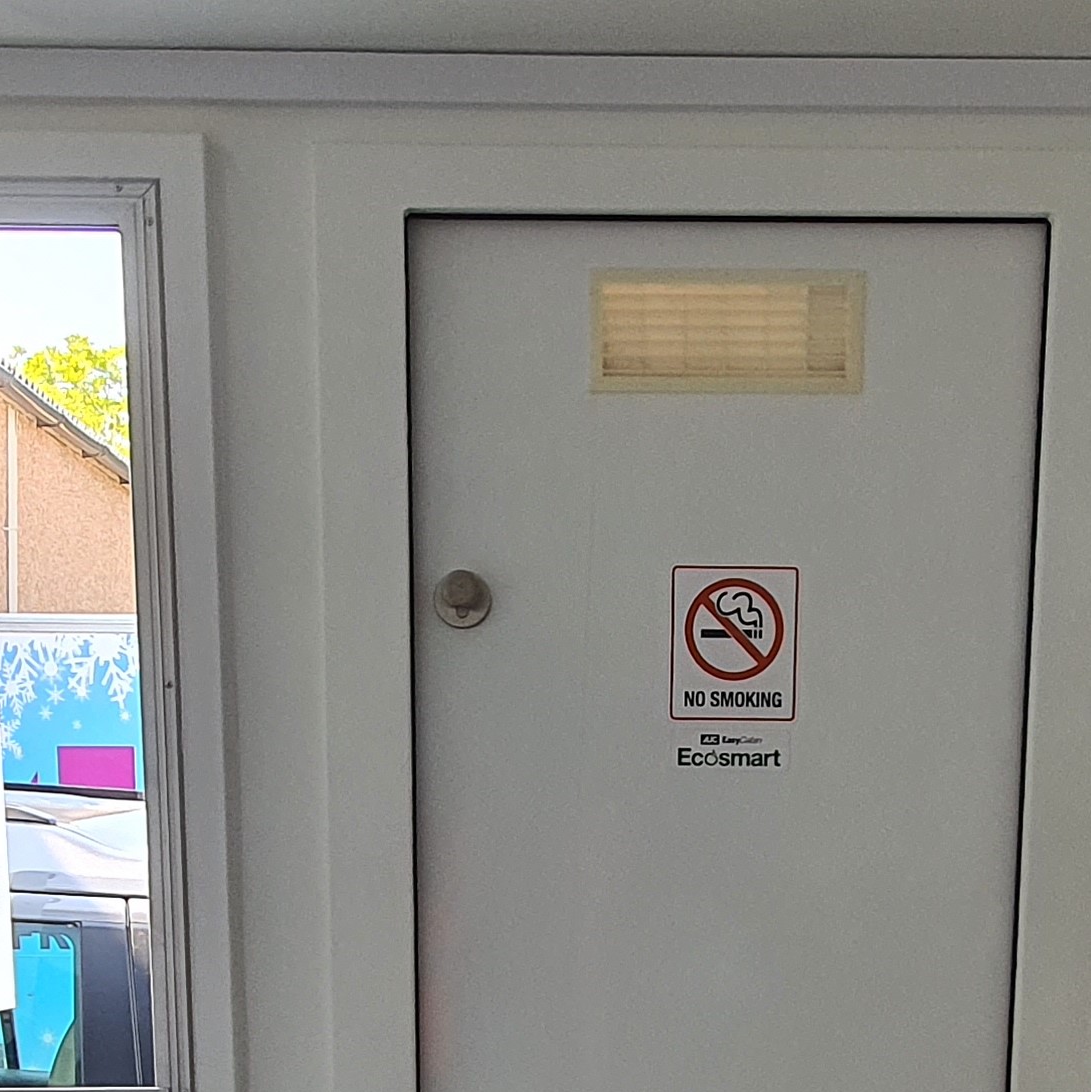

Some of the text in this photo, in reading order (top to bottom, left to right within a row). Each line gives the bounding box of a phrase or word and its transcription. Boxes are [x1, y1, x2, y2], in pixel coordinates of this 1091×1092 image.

[684, 691, 782, 708] NO SMOKING
[677, 748, 781, 767] Ecosmart
